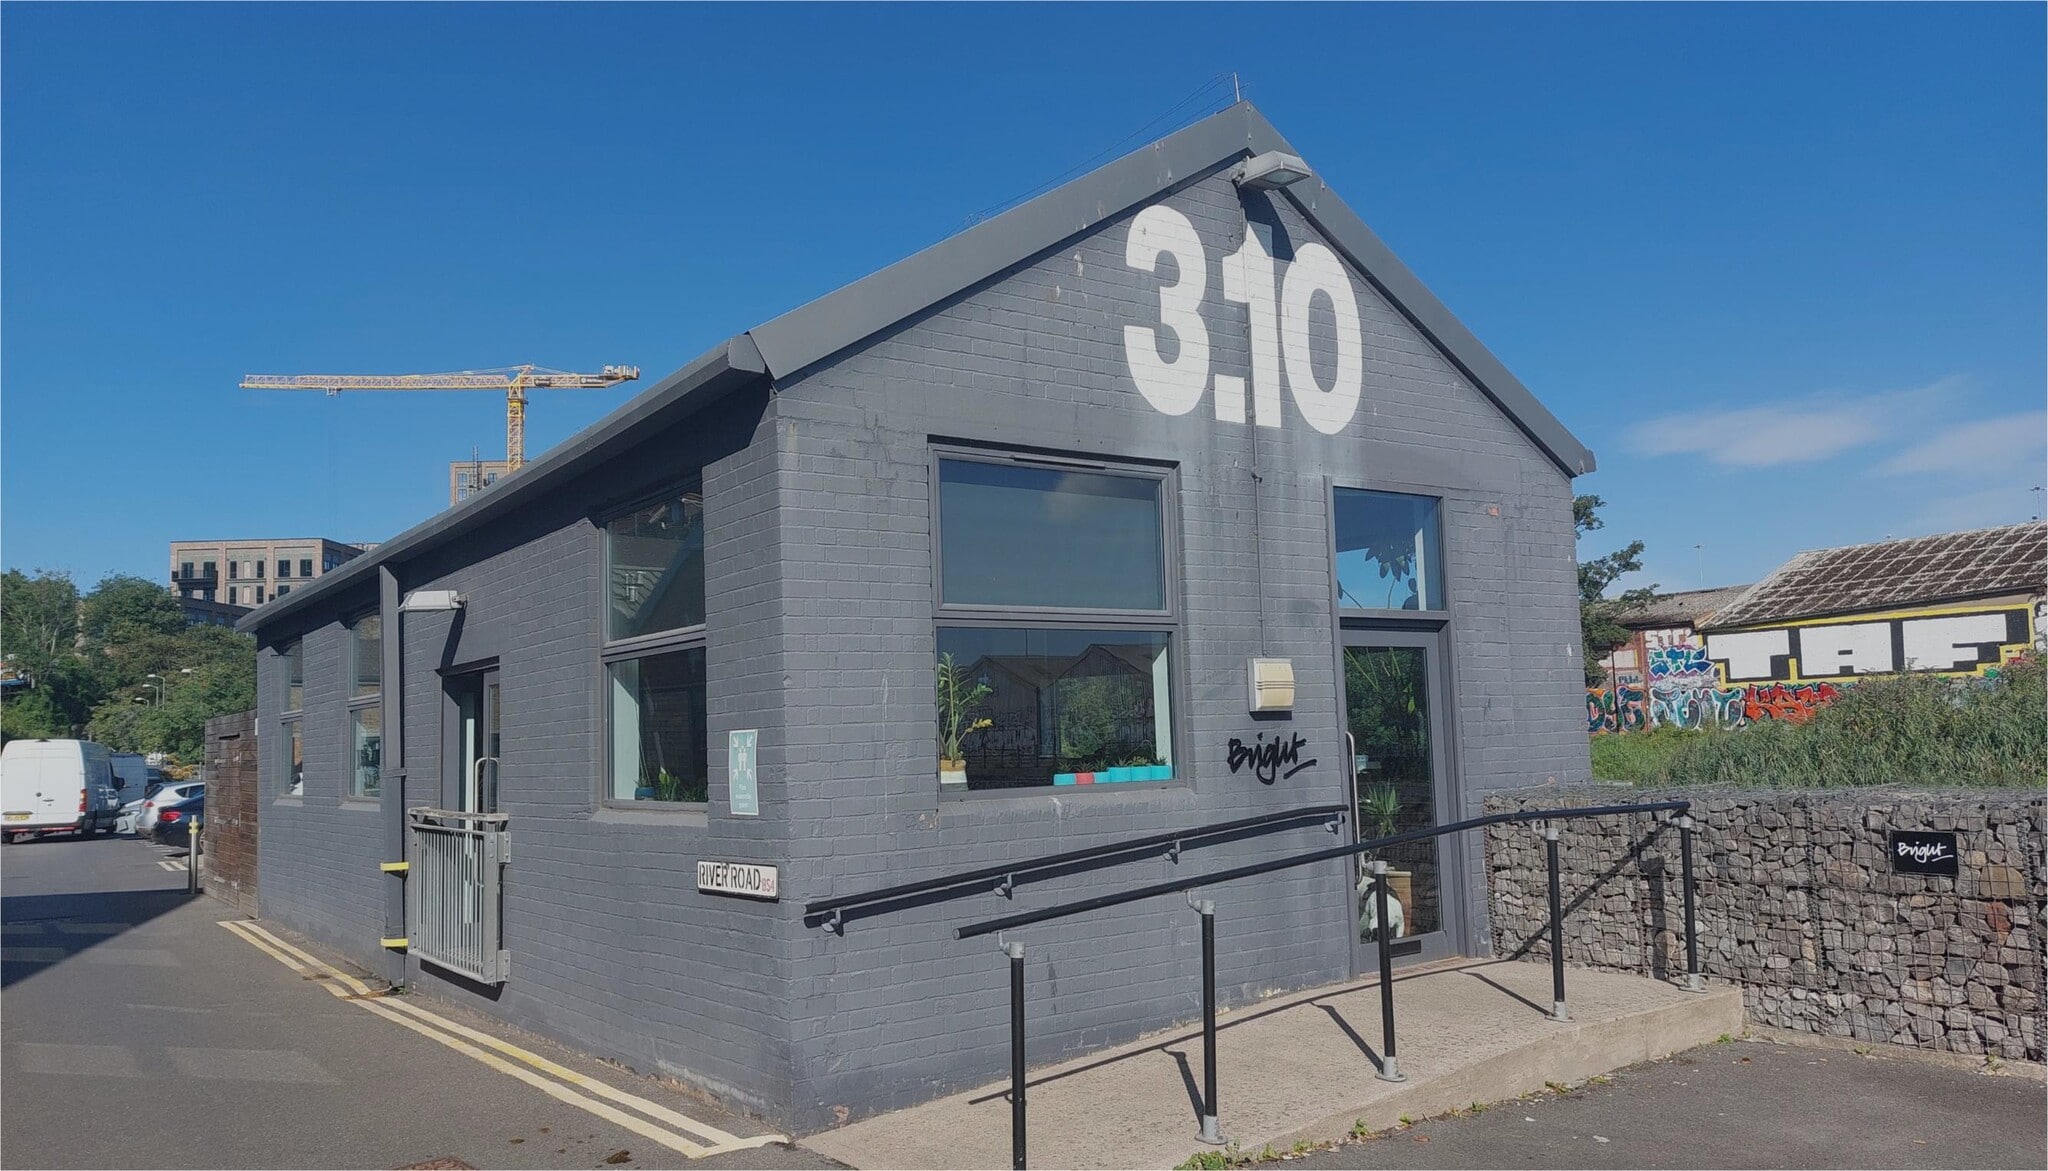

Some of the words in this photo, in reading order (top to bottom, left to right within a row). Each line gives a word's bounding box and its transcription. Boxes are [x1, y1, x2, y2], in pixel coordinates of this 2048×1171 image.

[1124, 205, 1362, 434] 3.10
[1227, 732, 1316, 785] Bright
[1898, 841, 1954, 863] Bright
[699, 863, 728, 887] RIVER
[730, 866, 761, 890] ROAD
